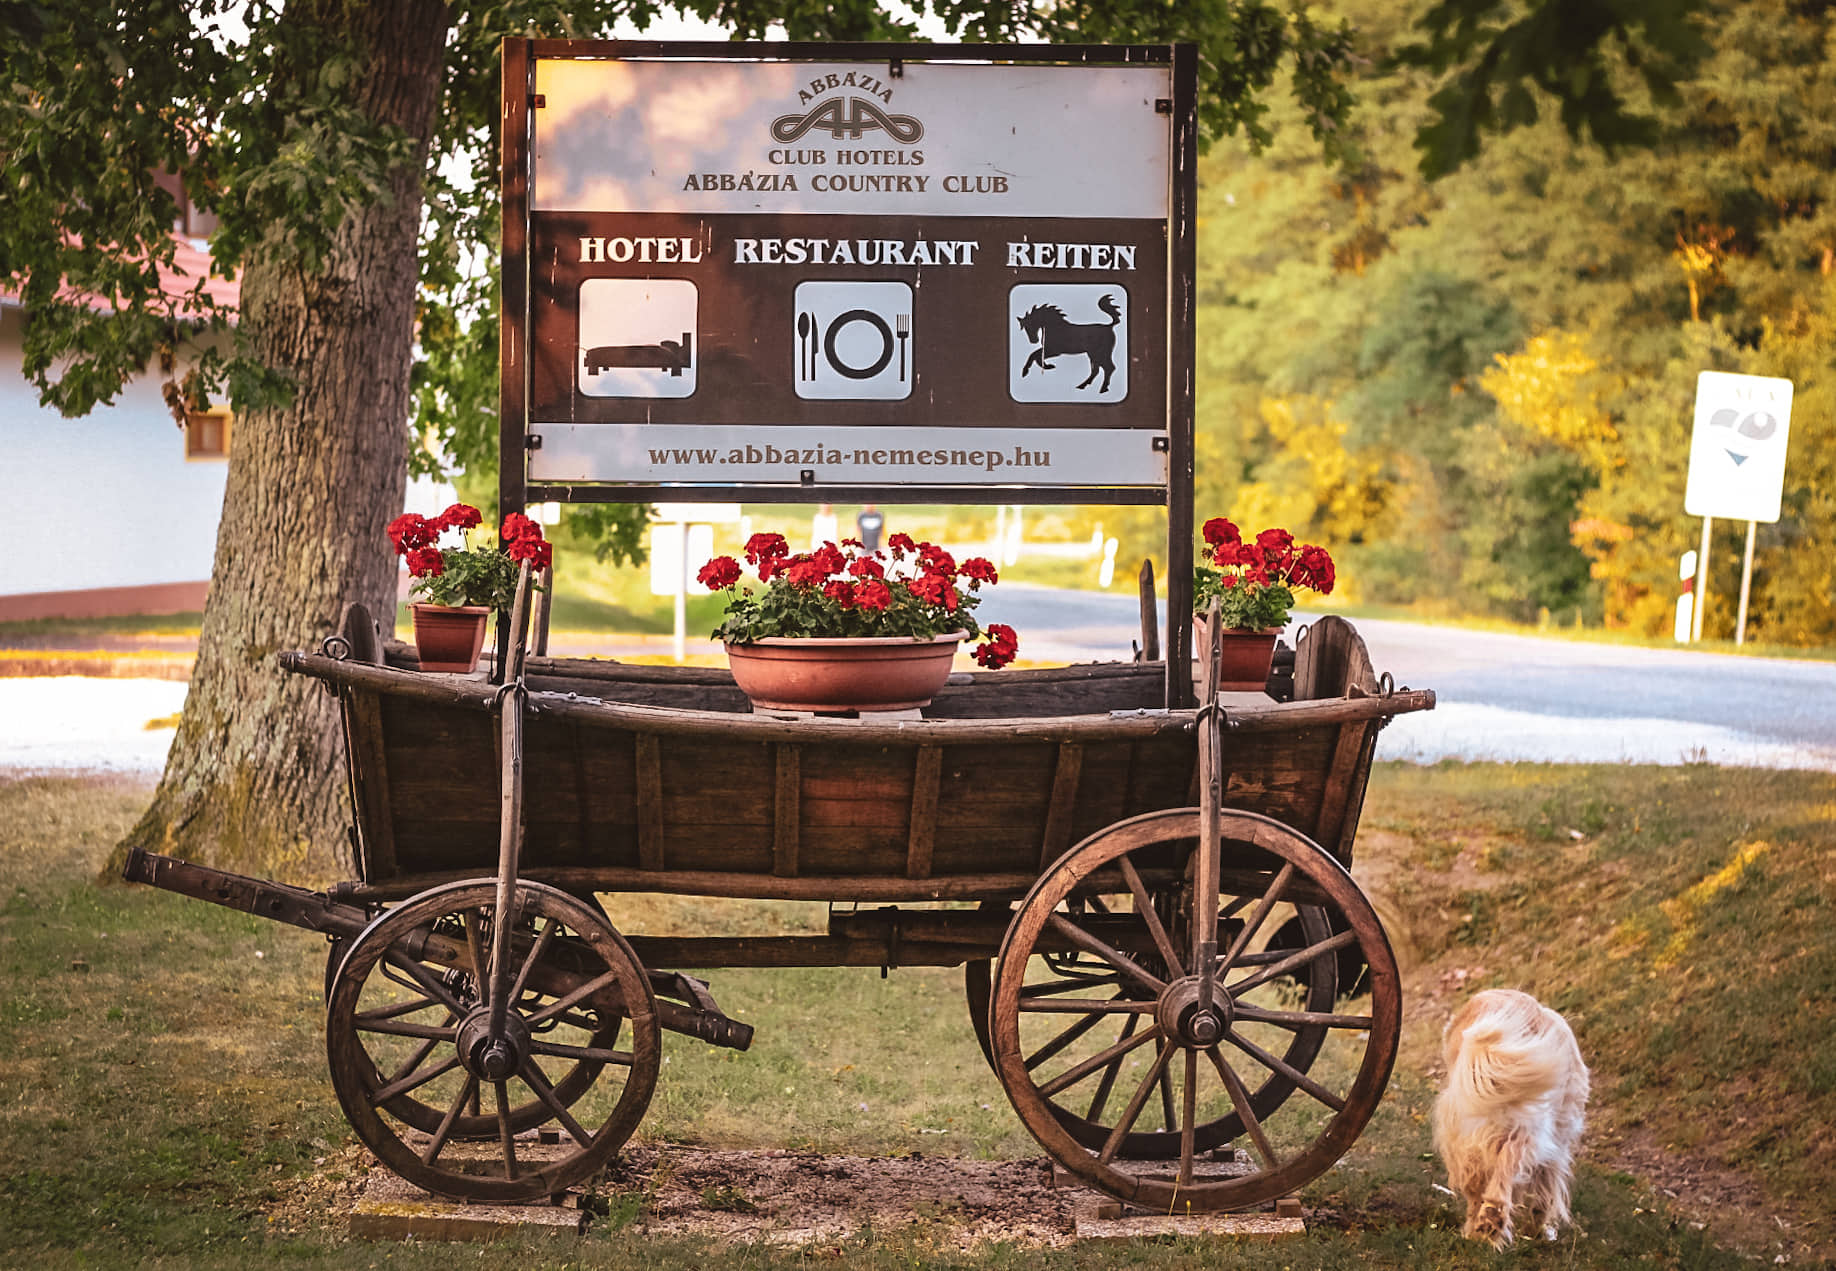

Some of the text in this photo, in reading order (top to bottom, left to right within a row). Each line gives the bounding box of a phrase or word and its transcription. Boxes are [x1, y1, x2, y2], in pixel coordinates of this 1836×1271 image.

[768, 149, 925, 167] CLUB HOTELS
[810, 174, 930, 194] COUNTRY
[942, 175, 1010, 194] CLUB
[578, 236, 1138, 271] HOTEL RESTAURANT REITEN
[648, 443, 1053, 473] www.abbazia-nemesnep.hu
